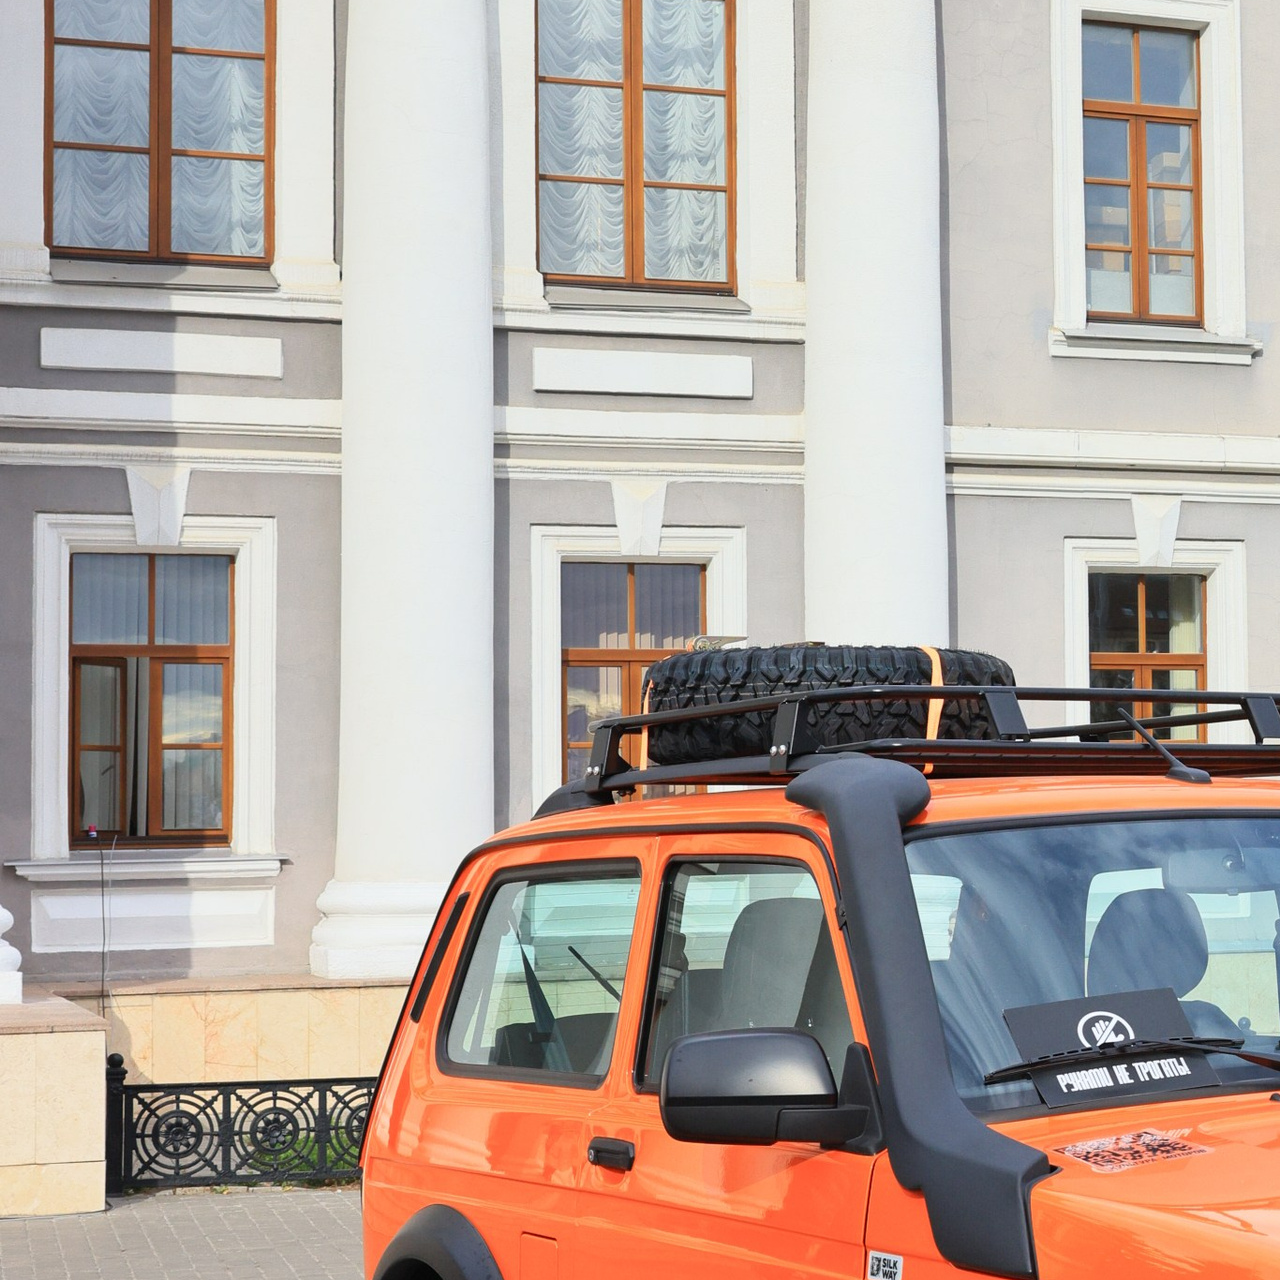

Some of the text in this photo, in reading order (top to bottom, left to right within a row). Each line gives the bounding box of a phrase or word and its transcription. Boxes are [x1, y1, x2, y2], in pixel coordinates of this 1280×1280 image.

[1056, 1055, 1192, 1093] РУКАМИ НЕ ТРОГАТЬ!
[881, 1257, 899, 1271] SILK
[881, 1268, 898, 1280] WAY
